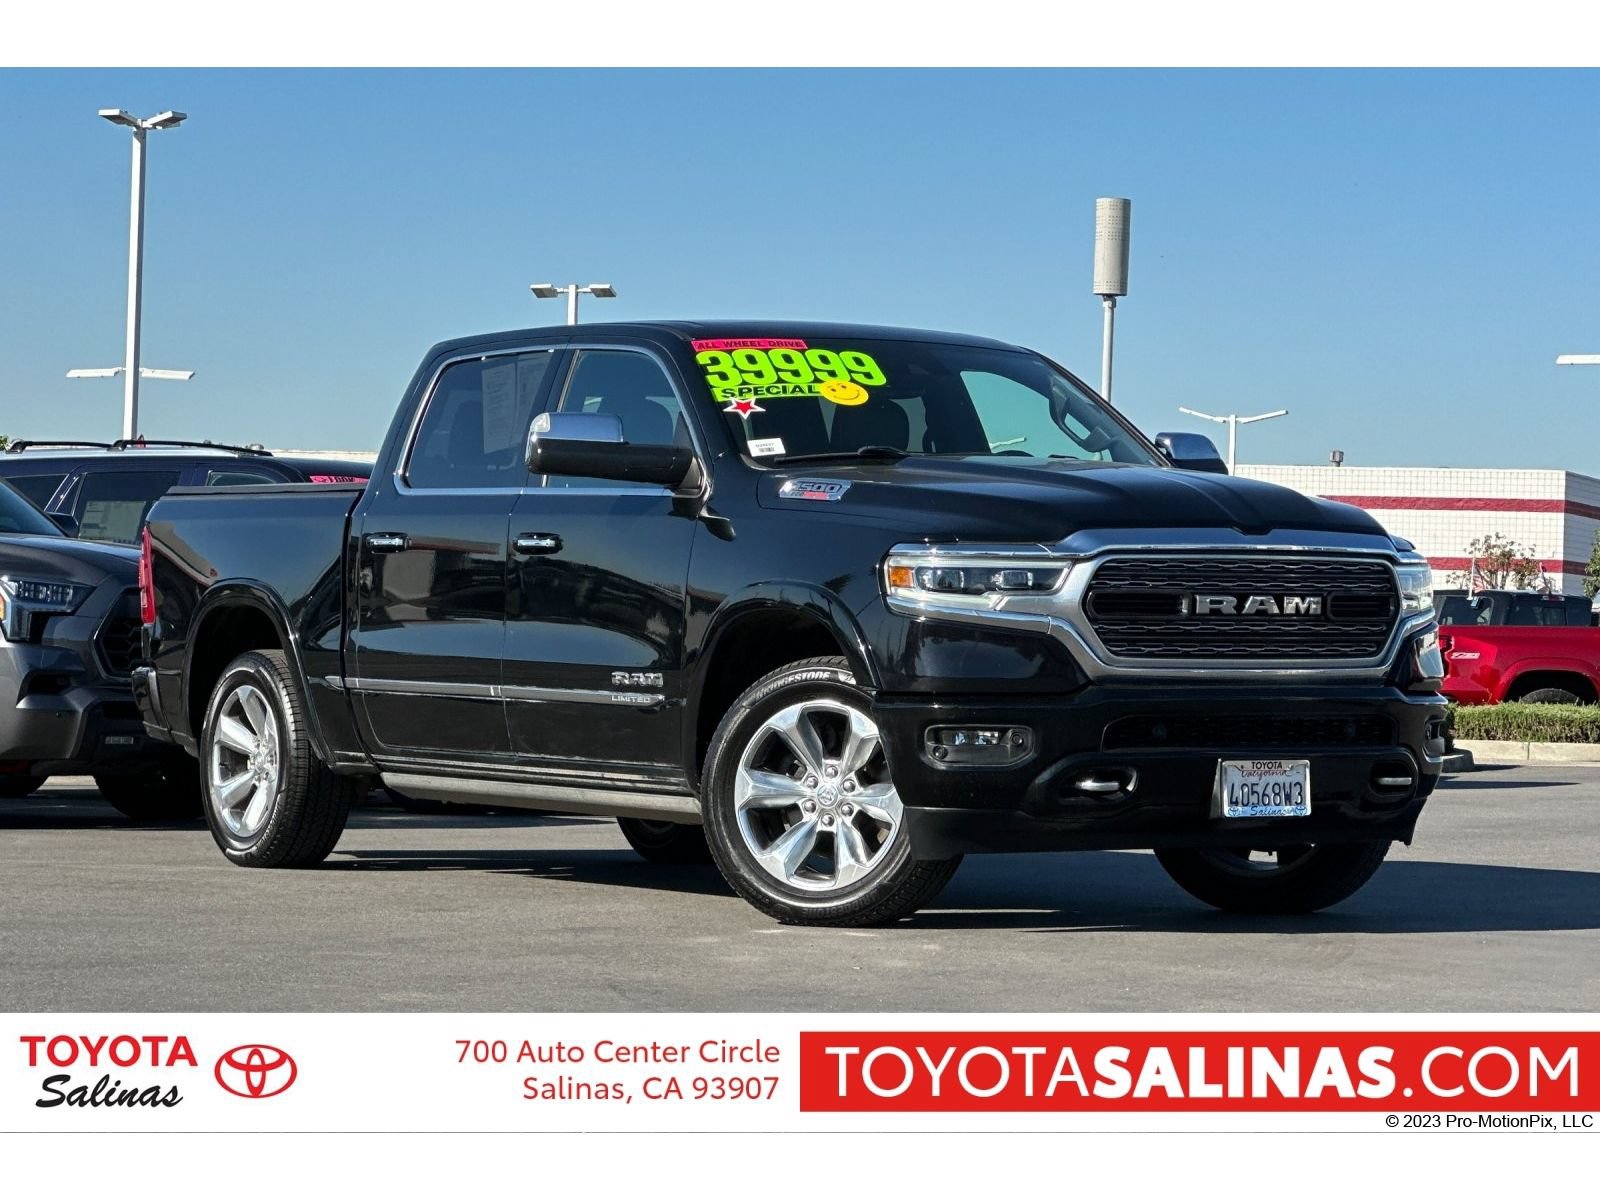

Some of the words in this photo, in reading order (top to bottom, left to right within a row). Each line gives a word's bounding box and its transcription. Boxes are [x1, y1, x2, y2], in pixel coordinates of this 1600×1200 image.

[697, 342, 720, 350] ALL
[768, 339, 804, 348] DRIVE
[695, 348, 887, 388] 39999
[721, 385, 820, 399] SPECIAL
[1194, 594, 1322, 615] RAM
[611, 671, 664, 687] RAM
[611, 694, 651, 703] LIMITED
[1252, 761, 1283, 770] TOYOTA
[1241, 769, 1292, 781] California
[1229, 782, 1303, 807] 40568W3
